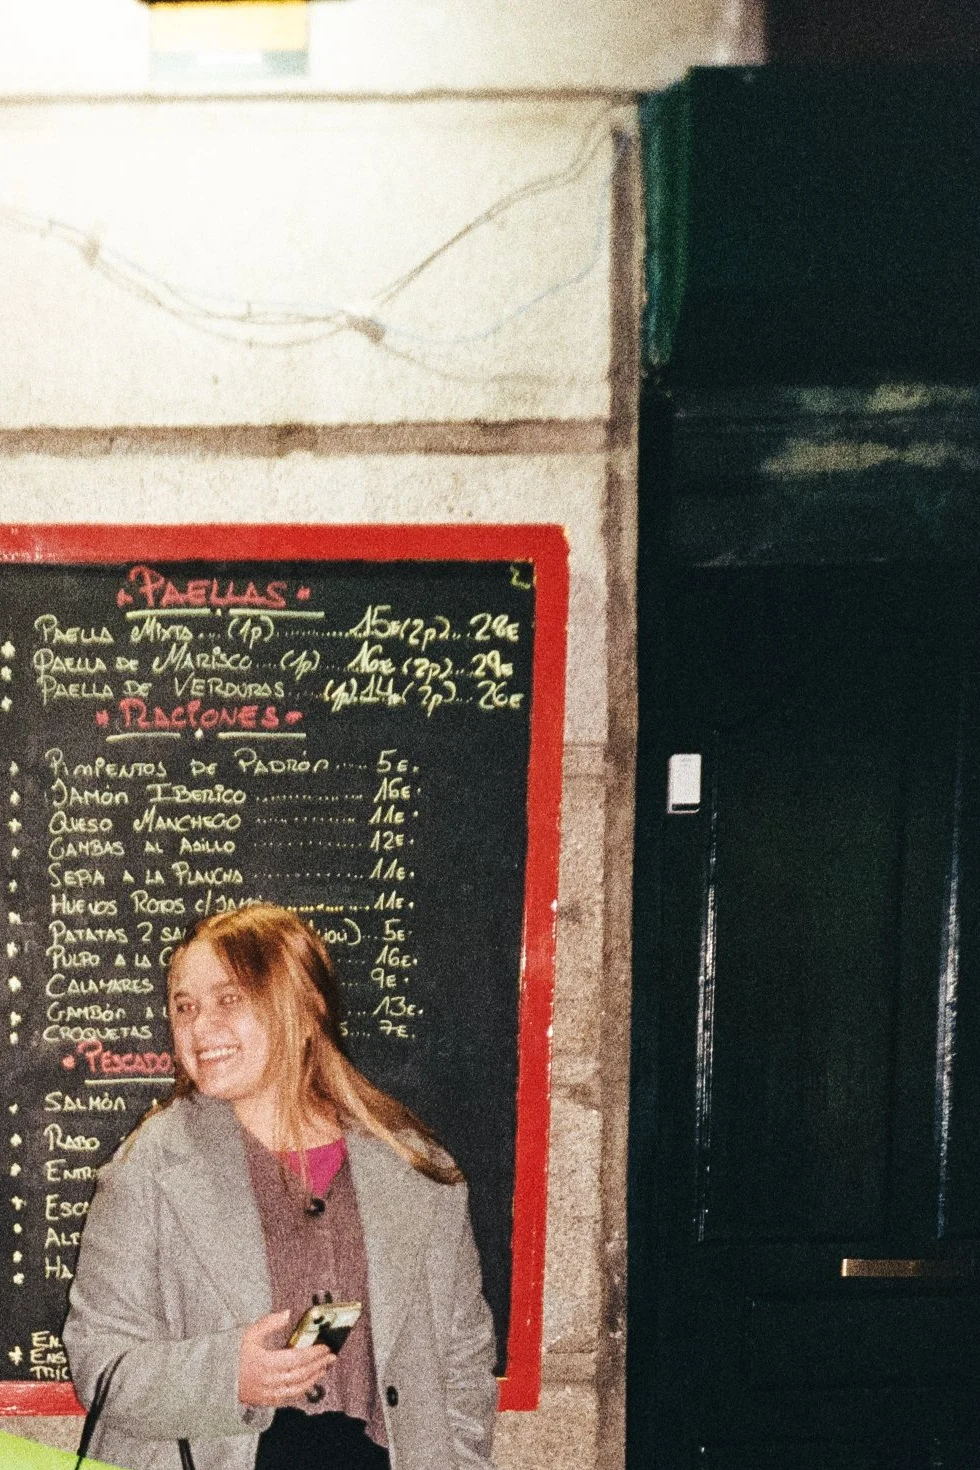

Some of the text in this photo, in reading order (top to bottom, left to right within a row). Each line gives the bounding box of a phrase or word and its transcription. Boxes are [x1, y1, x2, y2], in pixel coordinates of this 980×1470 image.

[128, 565, 287, 609] PAELLAS
[34, 613, 115, 644] PAELLA
[130, 616, 194, 644] MIXTA
[32, 647, 108, 680] PAELLA
[151, 642, 253, 676] MARISCO
[36, 674, 115, 706] PAELLA
[174, 671, 285, 699] VERDURAS
[119, 697, 280, 729] RACIONES
[48, 810, 114, 834] QUESO
[48, 919, 129, 946] PATATAS
[46, 944, 101, 970] PULPO
[45, 973, 155, 999] CALAMARES
[42, 1024, 153, 1043] CROQUETAS
[76, 1038, 174, 1074] PESCADO
